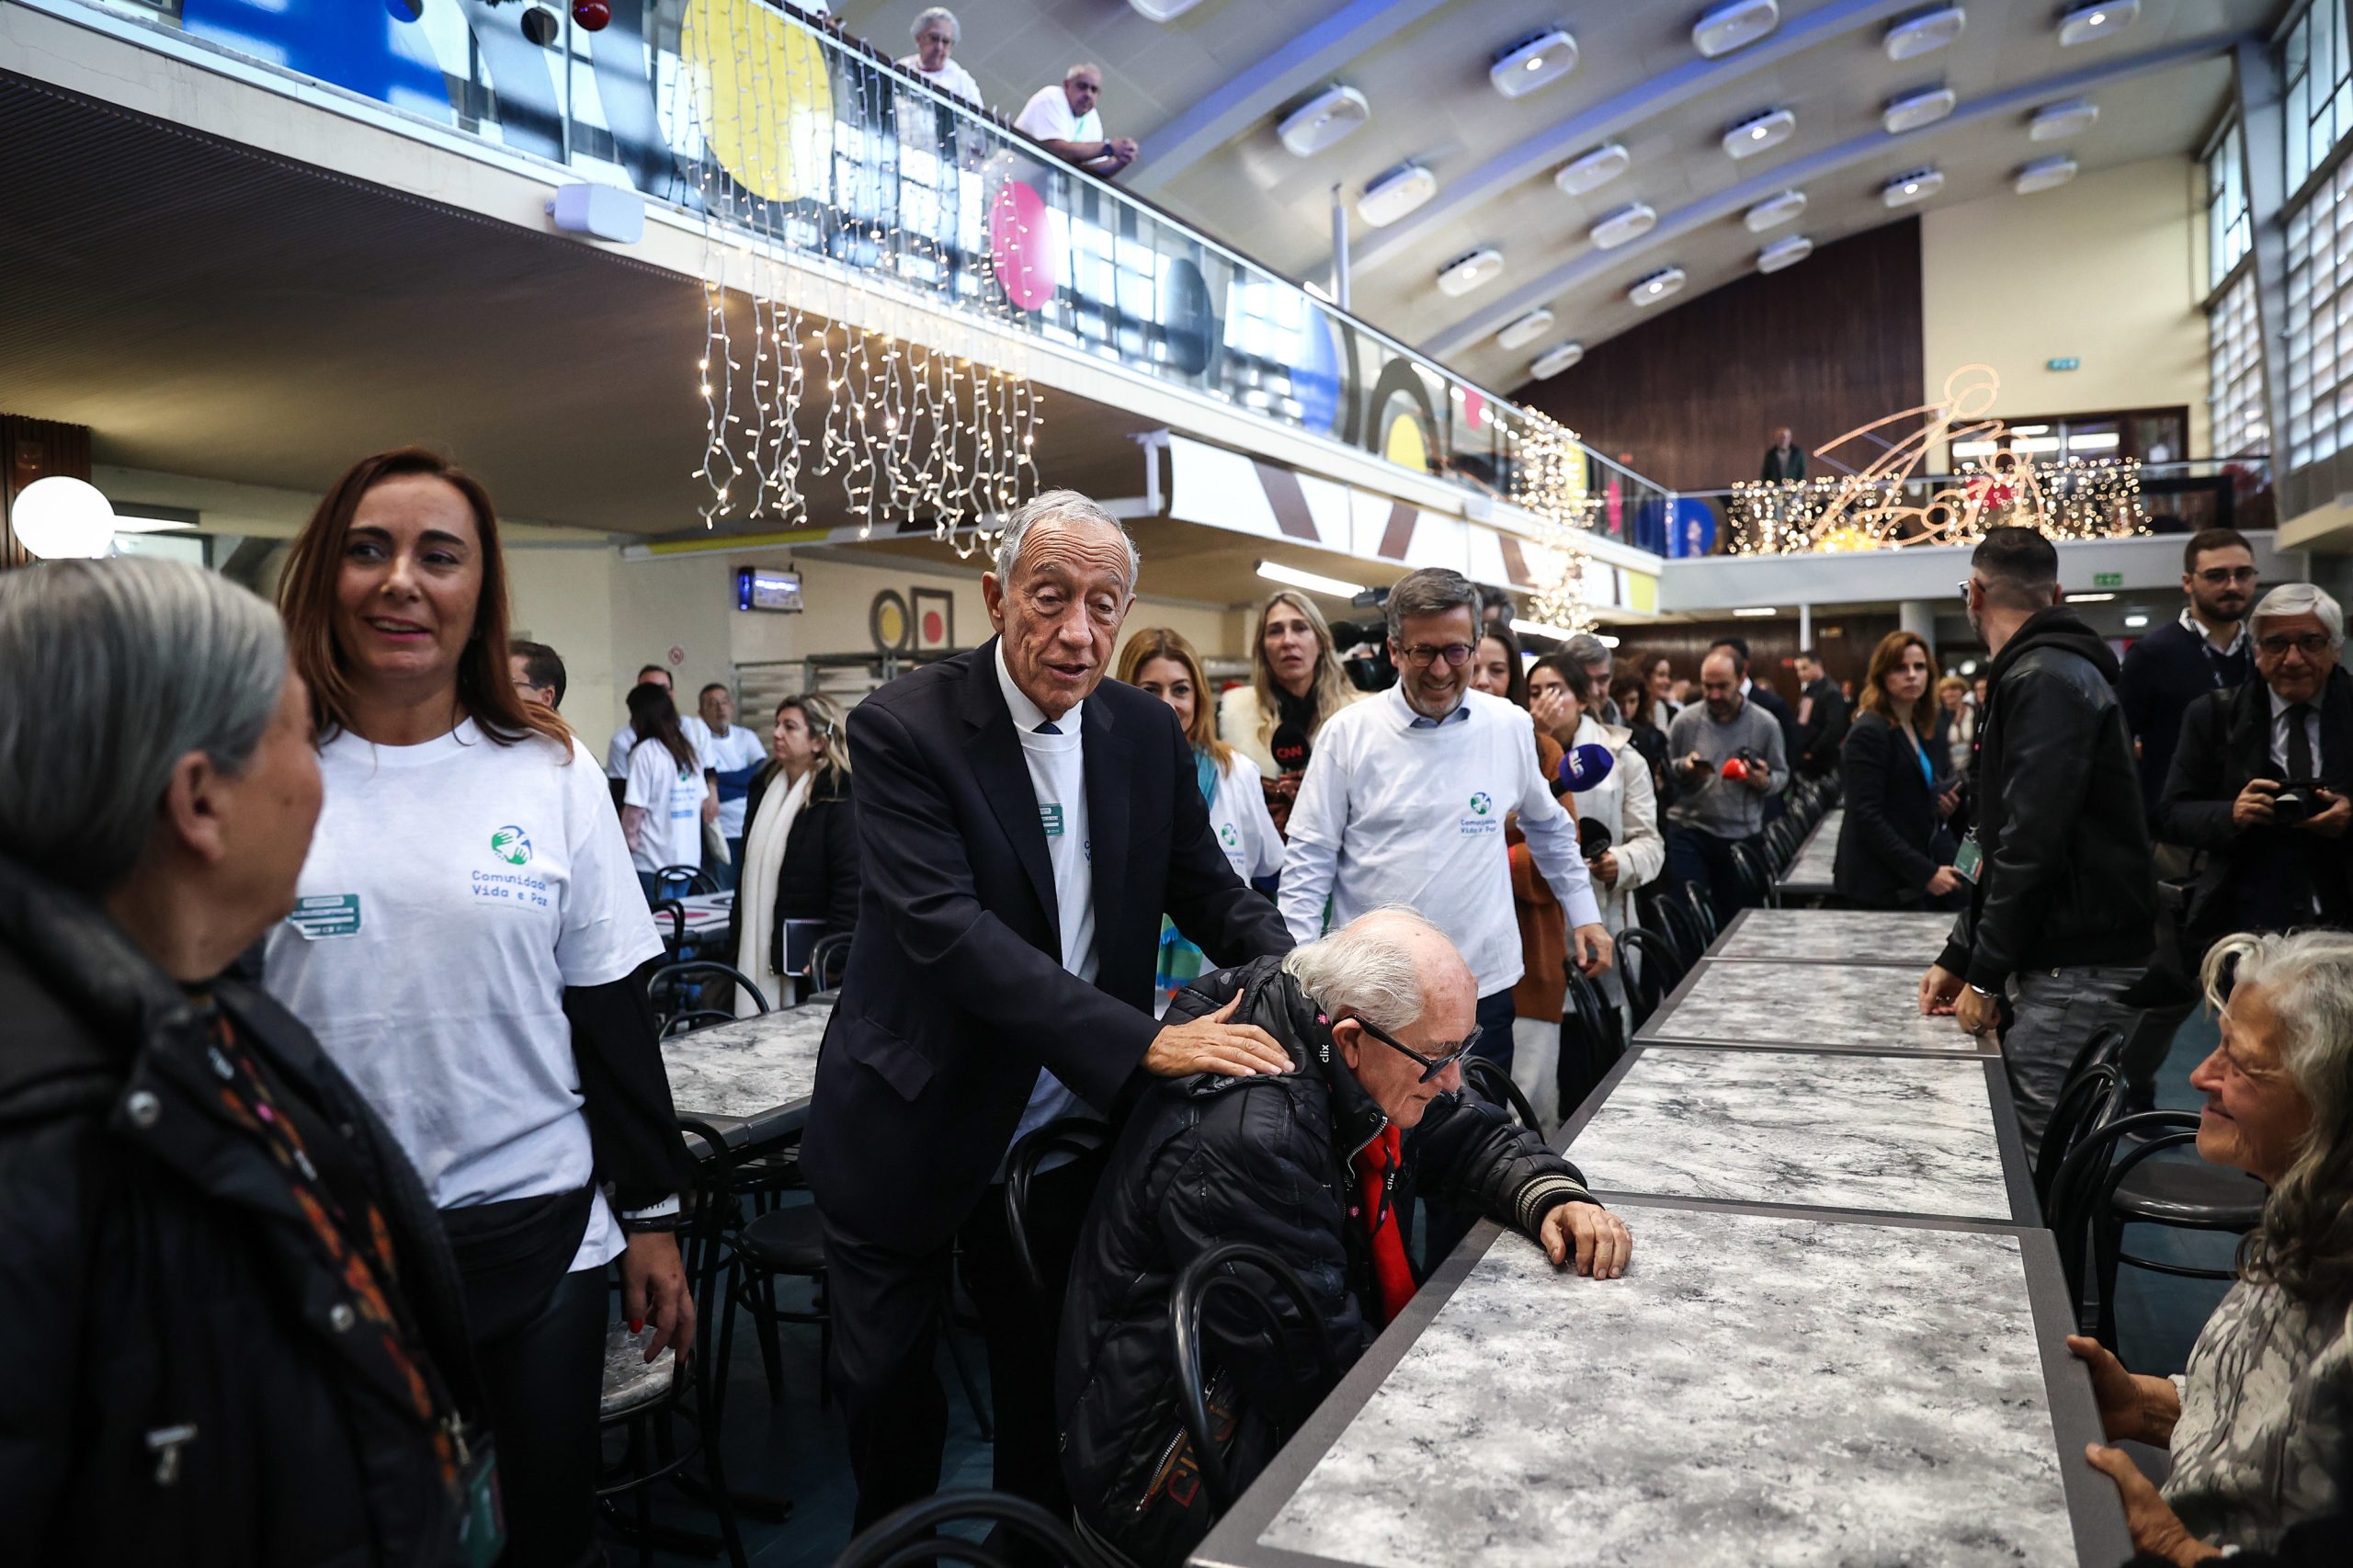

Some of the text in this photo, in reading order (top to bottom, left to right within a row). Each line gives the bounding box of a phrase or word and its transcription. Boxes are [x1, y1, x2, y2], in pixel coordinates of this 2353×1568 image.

[1276, 744, 1302, 759] CNN
[472, 883, 548, 907] Vida e Paz
[1319, 1044, 1330, 1062] clix
[1387, 1173, 1395, 1190] clix
